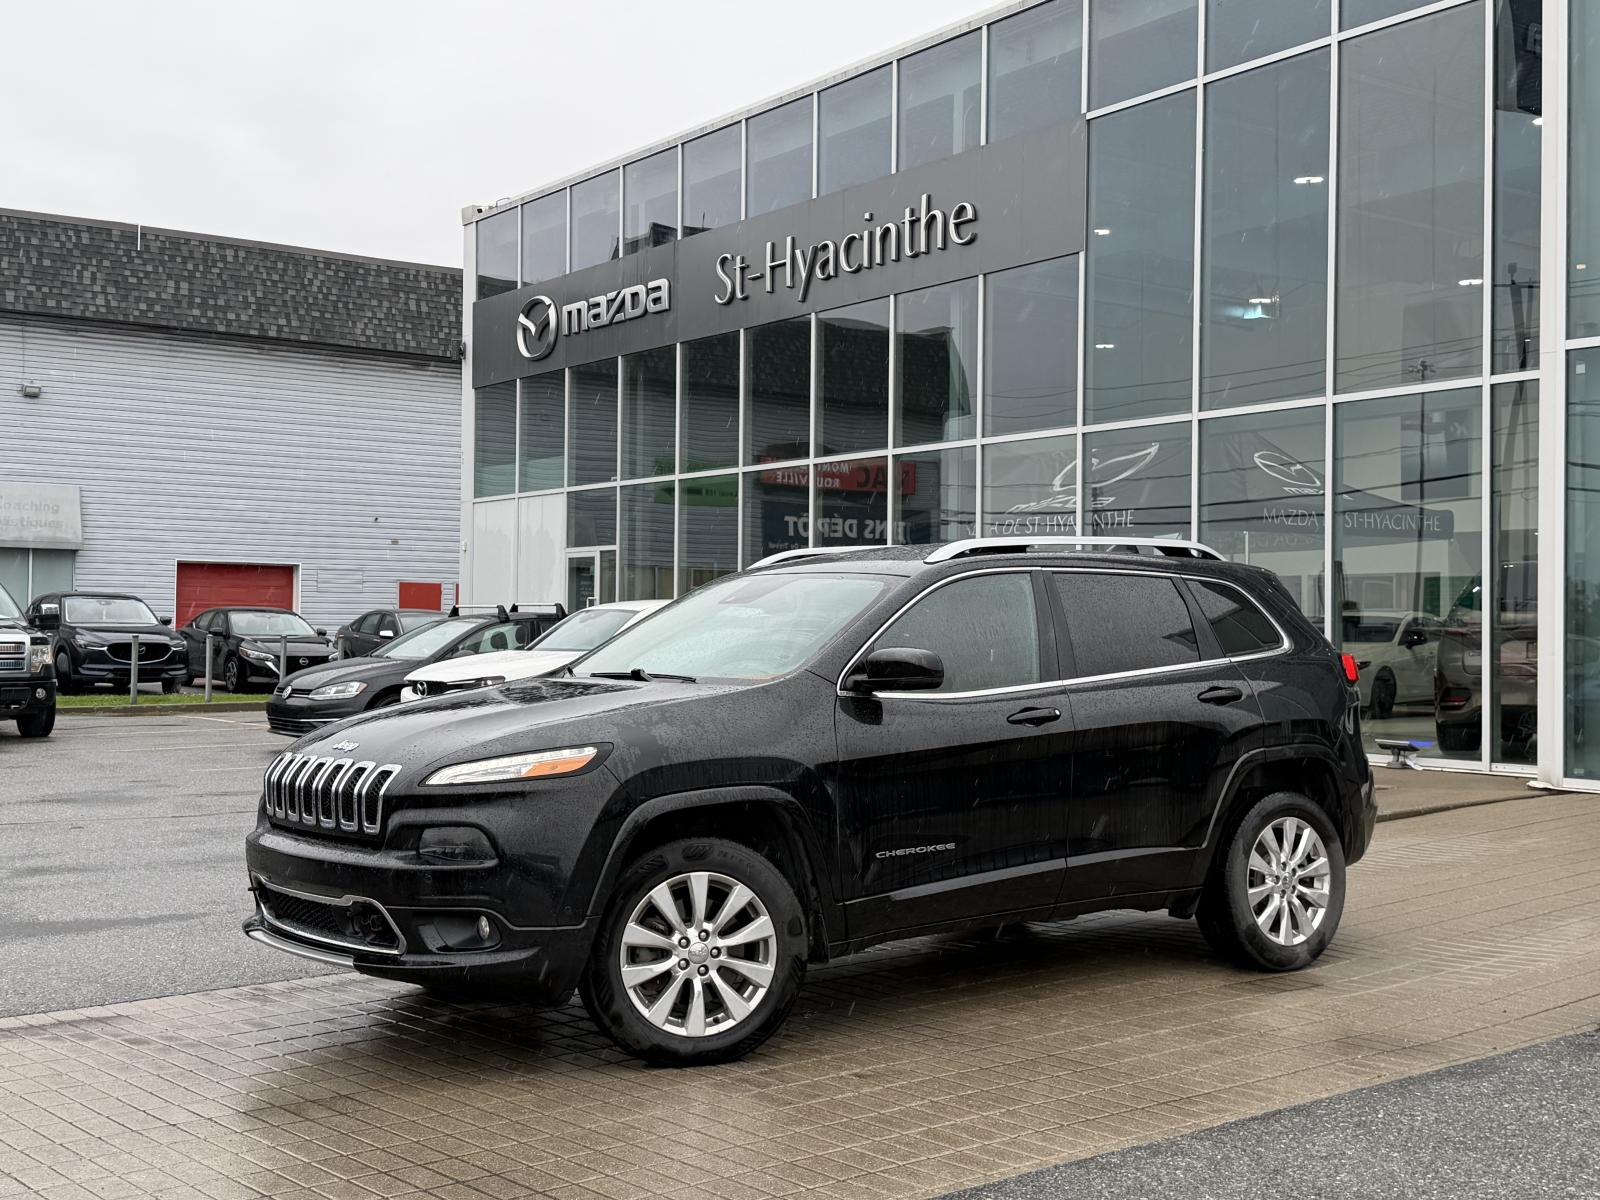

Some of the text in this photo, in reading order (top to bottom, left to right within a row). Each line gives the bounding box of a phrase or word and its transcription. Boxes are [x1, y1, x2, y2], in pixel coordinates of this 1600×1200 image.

[714, 194, 979, 305] St-Hyacinthe
[561, 277, 671, 337] mazda
[0, 496, 60, 514] oaching
[1024, 509, 1135, 534] ST-HYANTHE
[1263, 507, 1319, 529] MAZDA
[875, 842, 956, 859] CHEROKEE
